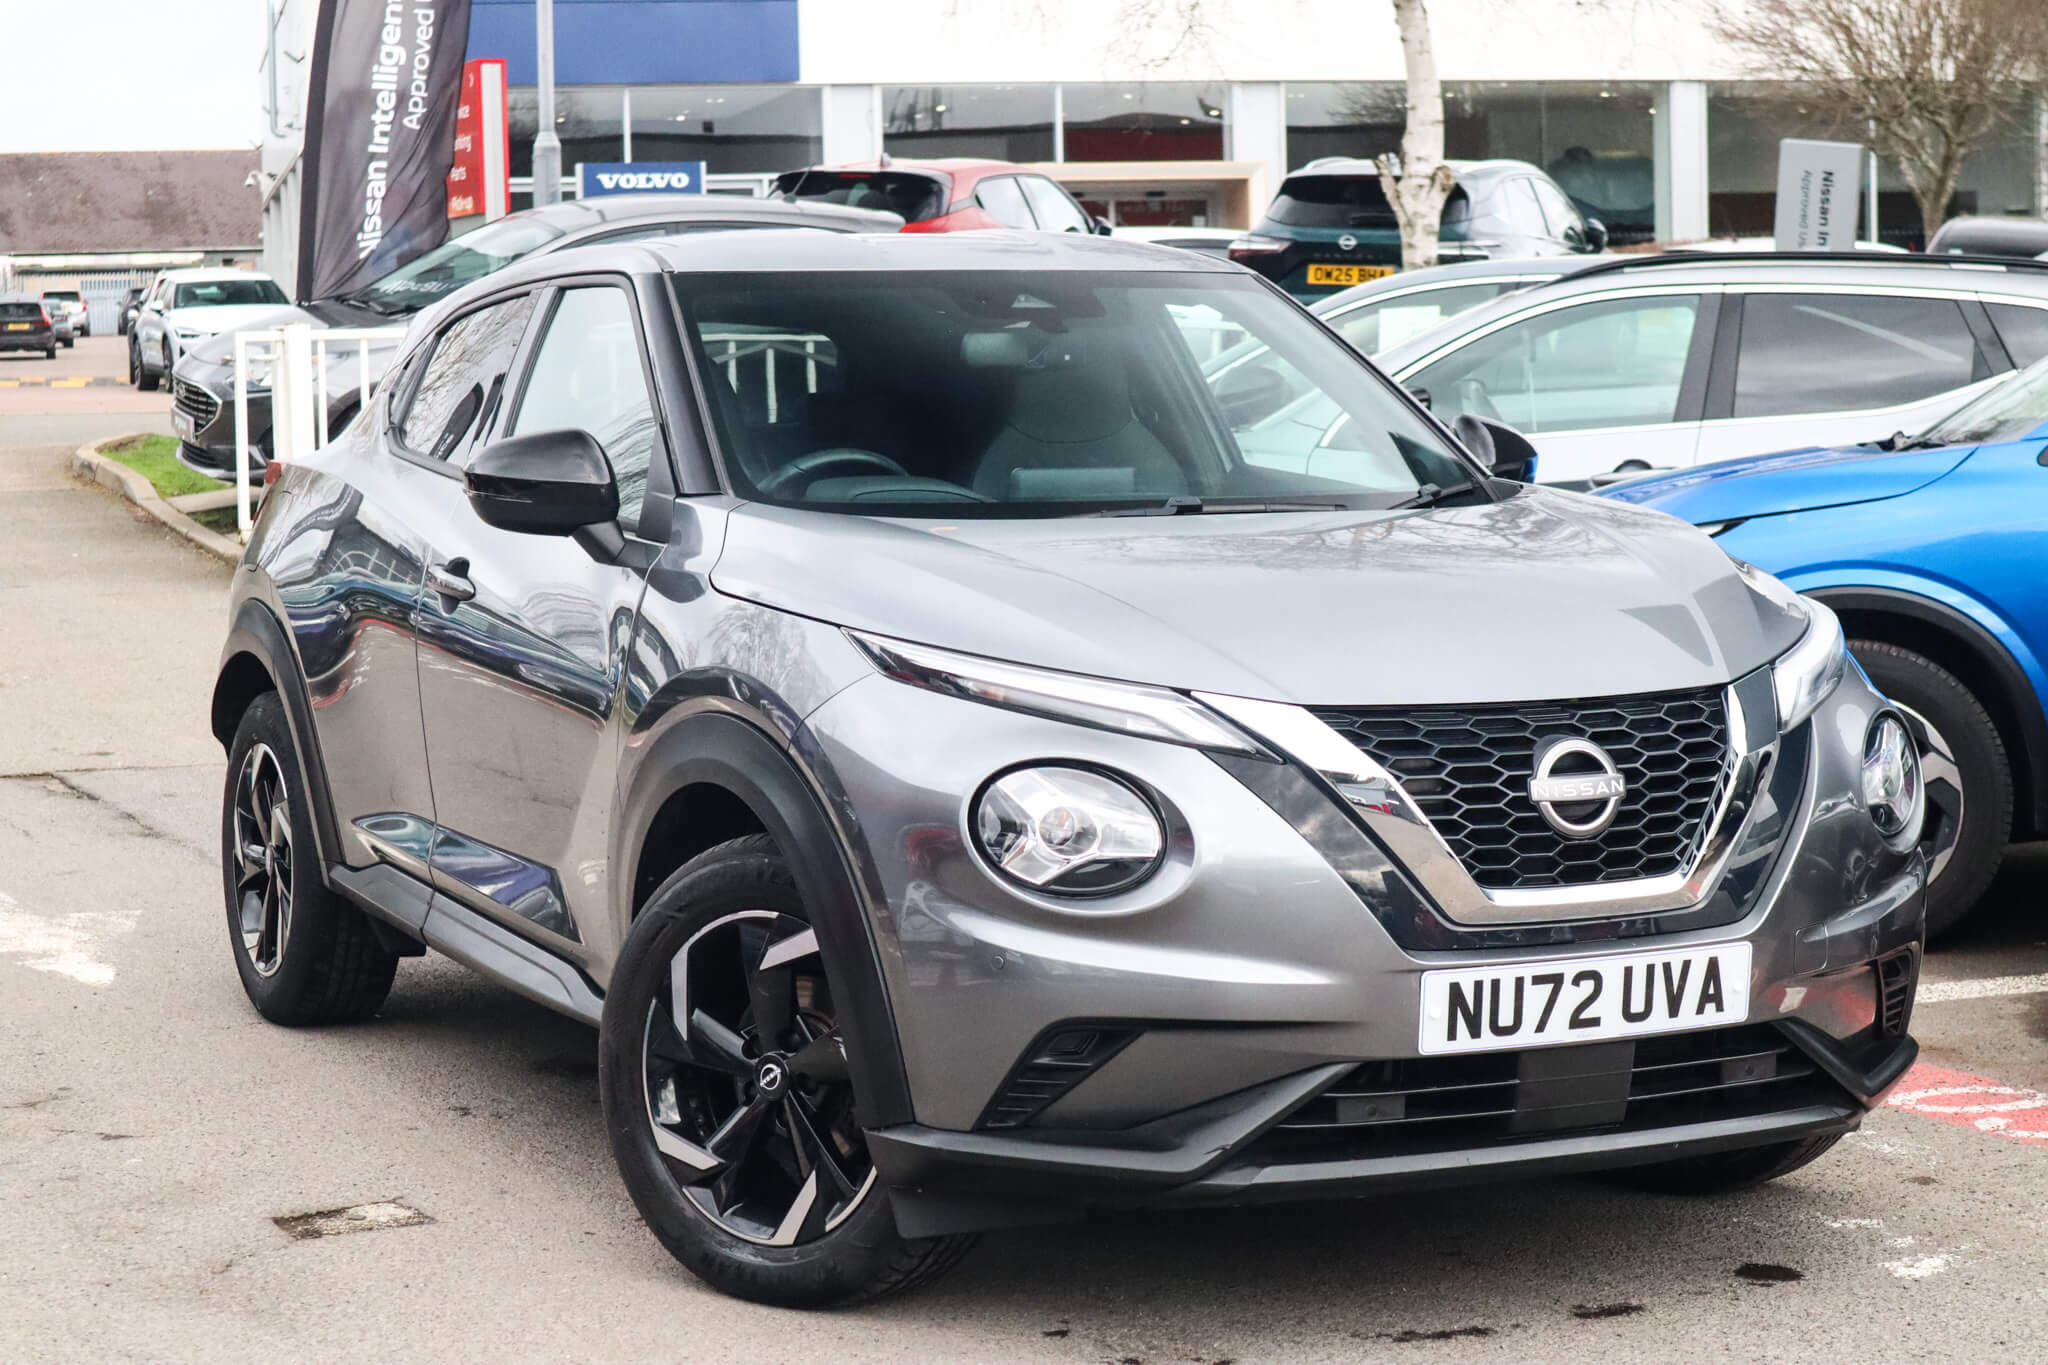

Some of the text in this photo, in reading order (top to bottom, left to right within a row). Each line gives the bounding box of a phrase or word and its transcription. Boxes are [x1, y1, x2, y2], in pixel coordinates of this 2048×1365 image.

[402, 8, 435, 130] Approved
[356, 0, 407, 260] Nissan Intelligen
[596, 172, 690, 190] VOLVO
[1819, 169, 1835, 227] Nissan
[1535, 778, 1625, 799] NISSAN
[1447, 955, 1725, 1042] NU72 UVA
